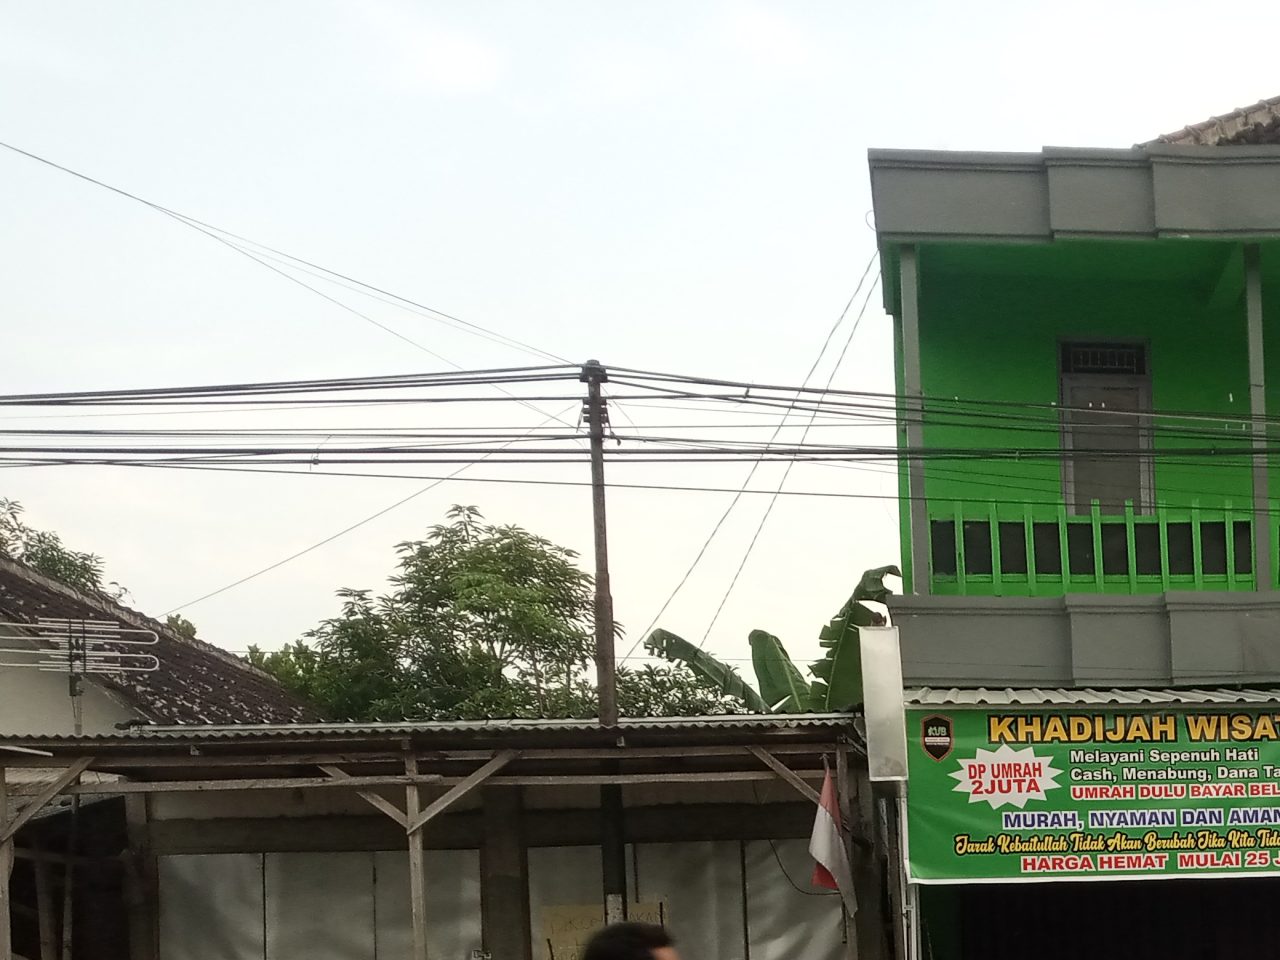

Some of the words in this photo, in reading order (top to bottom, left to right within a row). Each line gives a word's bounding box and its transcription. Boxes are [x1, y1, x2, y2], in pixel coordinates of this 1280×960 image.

[988, 714, 1177, 743] KHADIJAH
[1070, 749, 1144, 766] Melayani
[1149, 748, 1220, 765] Sepenuh
[1225, 747, 1259, 761] Hati
[968, 764, 986, 779] DP
[991, 762, 1042, 779] UMRAH
[1070, 767, 1118, 783] Cash,
[1122, 766, 1213, 782] Menabung,
[1217, 766, 1258, 779] Dana
[972, 778, 1041, 795] 2JUTA
[1071, 786, 1135, 799] UMRAH
[1139, 785, 1186, 798] DULU
[1191, 784, 1246, 797] BAYAR
[1003, 812, 1083, 830] MURAH,
[1090, 811, 1175, 828] NYAMAN
[1181, 809, 1223, 826] DAN
[955, 835, 996, 855] Jarak
[997, 833, 1068, 854] Kebaitullah
[1069, 831, 1105, 853] Tidak
[1106, 832, 1142, 852] Akan
[1143, 831, 1197, 851] Berubah
[1227, 830, 1256, 848] Kita
[1022, 856, 1094, 872] HARGA
[1098, 854, 1168, 870] HEMAT
[1178, 853, 1240, 868] MULAI
[1245, 852, 1269, 866] 25
